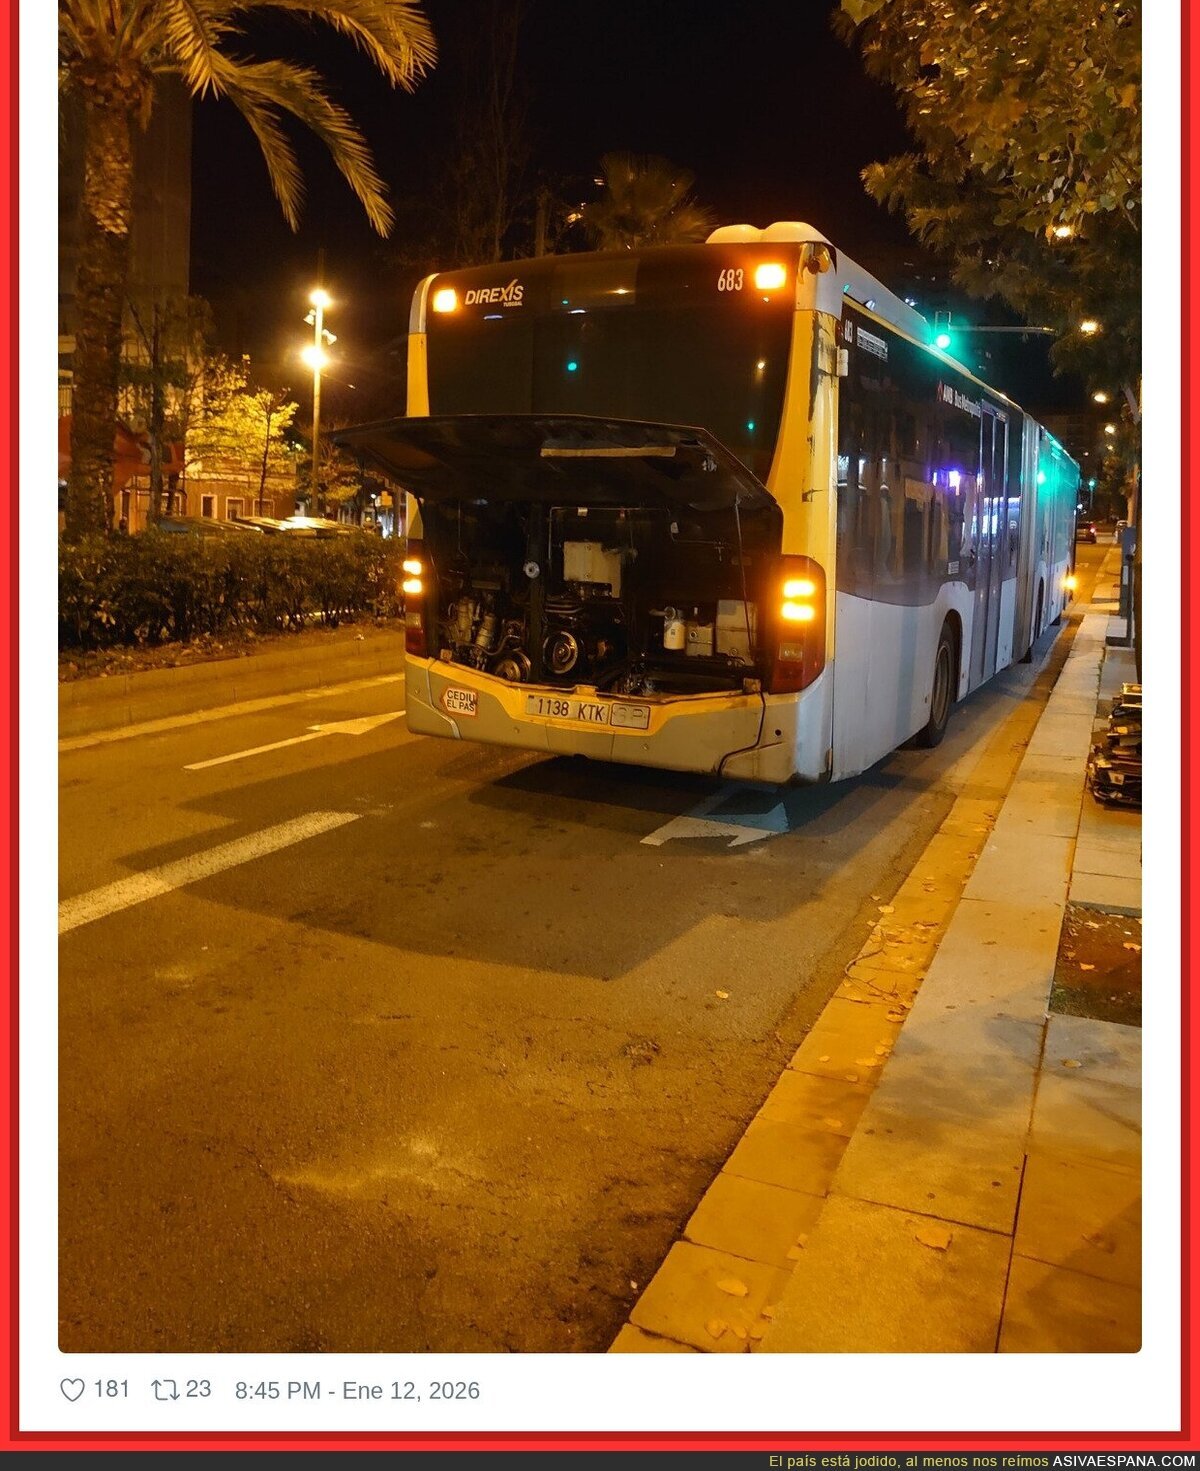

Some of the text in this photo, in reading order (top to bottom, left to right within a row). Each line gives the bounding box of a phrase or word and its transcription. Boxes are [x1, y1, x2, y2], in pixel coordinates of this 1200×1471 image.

[465, 278, 524, 306] DIREXIS
[717, 268, 744, 292] 683
[539, 698, 605, 722] 1138 KTK
